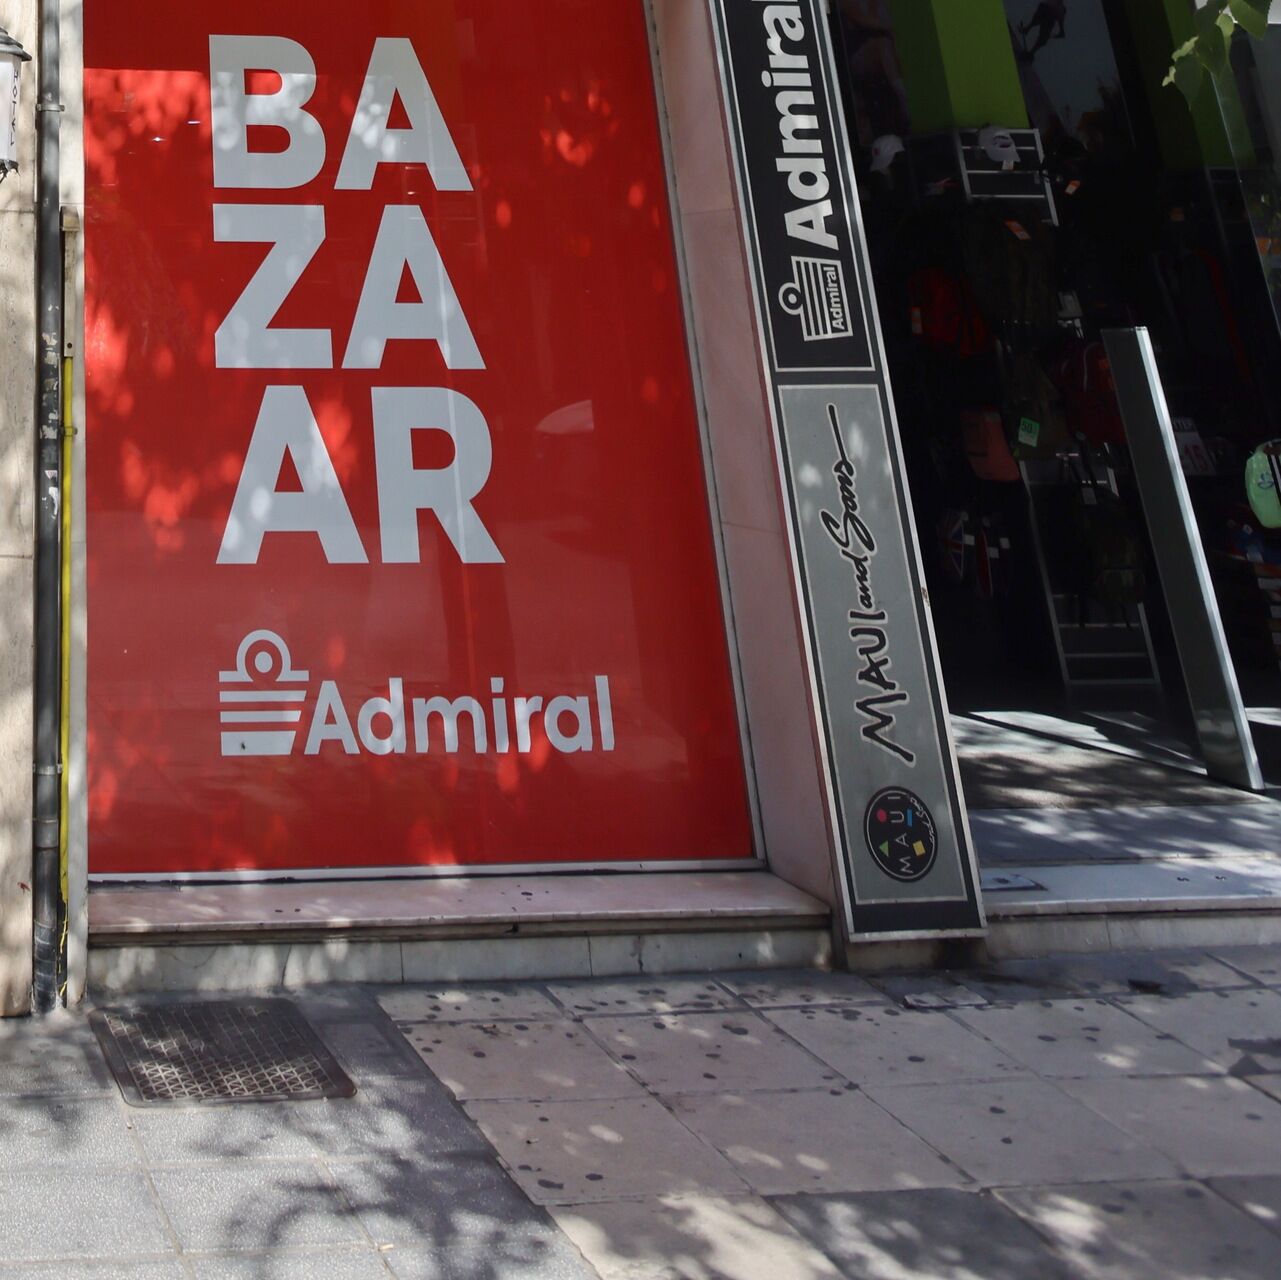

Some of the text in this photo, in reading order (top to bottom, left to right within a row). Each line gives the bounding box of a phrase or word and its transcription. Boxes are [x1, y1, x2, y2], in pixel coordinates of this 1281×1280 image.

[208, 34, 474, 192] BA
[212, 202, 487, 371] ZA
[823, 265, 846, 331] Admiral
[216, 384, 506, 564] AR
[304, 674, 616, 756] Admiral
[887, 796, 914, 874] MAUI
